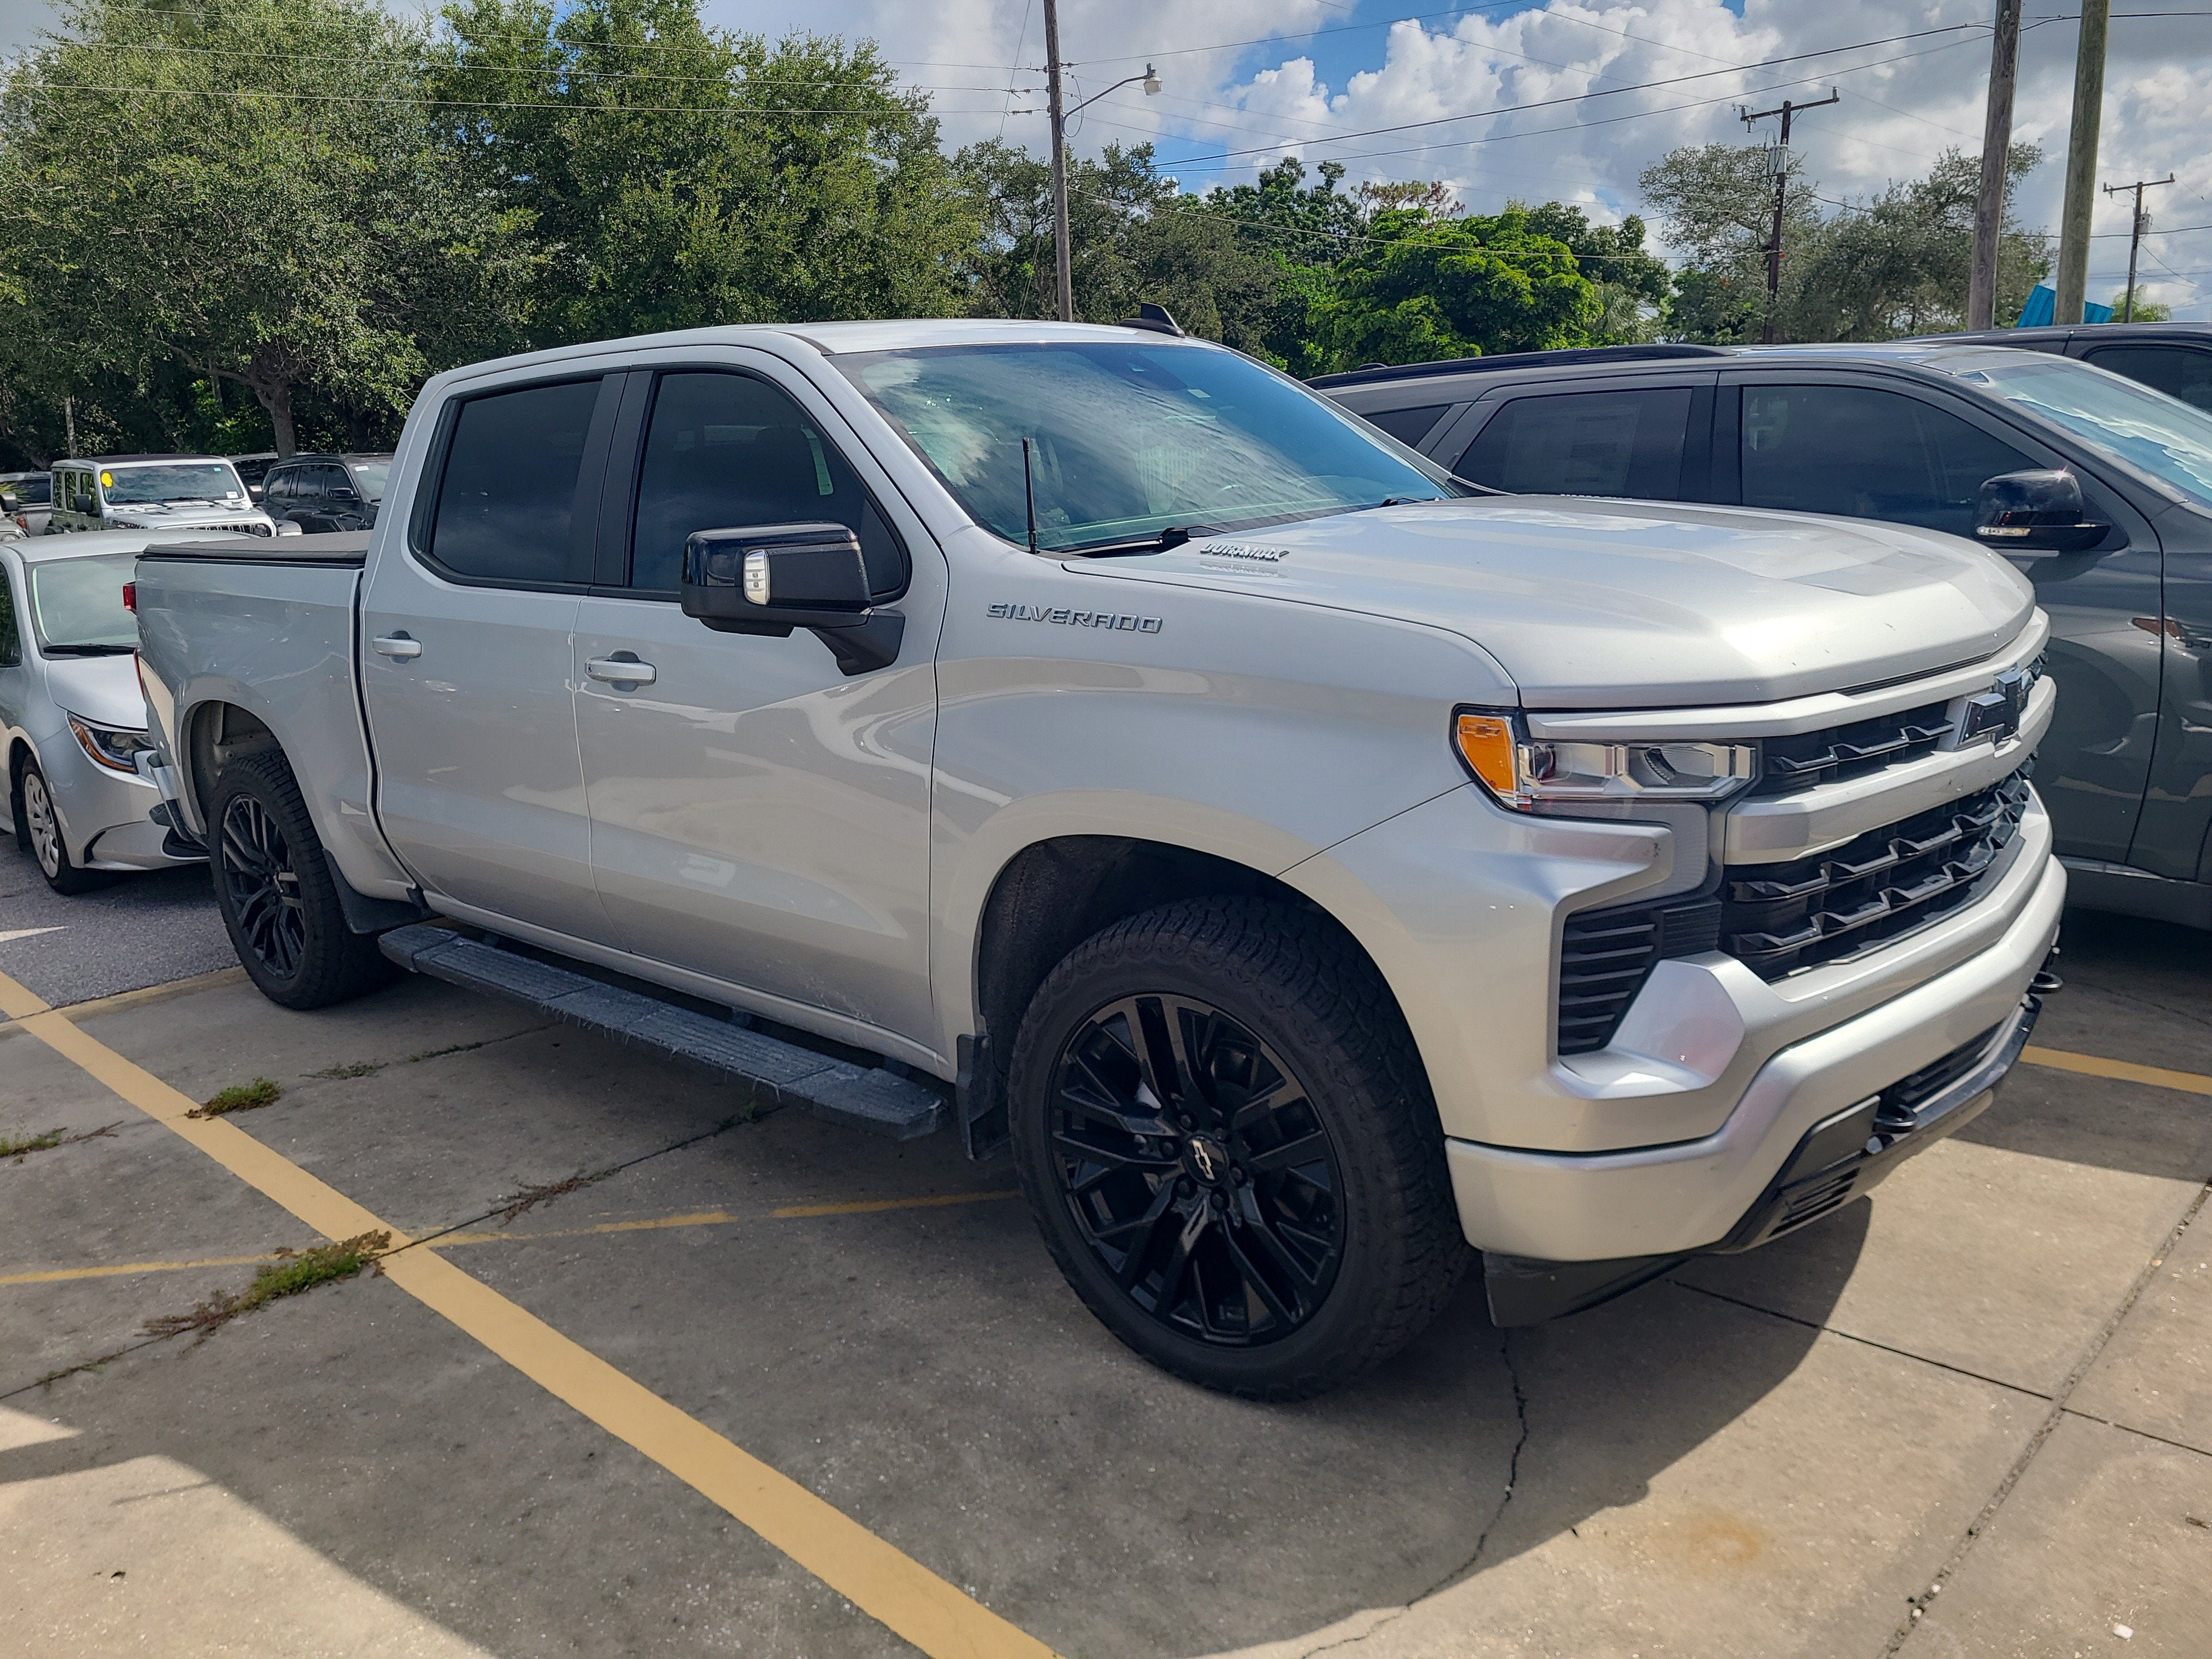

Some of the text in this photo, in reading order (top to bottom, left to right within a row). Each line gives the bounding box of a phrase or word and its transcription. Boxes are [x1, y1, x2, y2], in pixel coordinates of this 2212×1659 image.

[112, 520, 141, 529] RUBICON
[1200, 543, 1290, 562] DURAMAX
[986, 602, 1163, 634] SILVERADO
